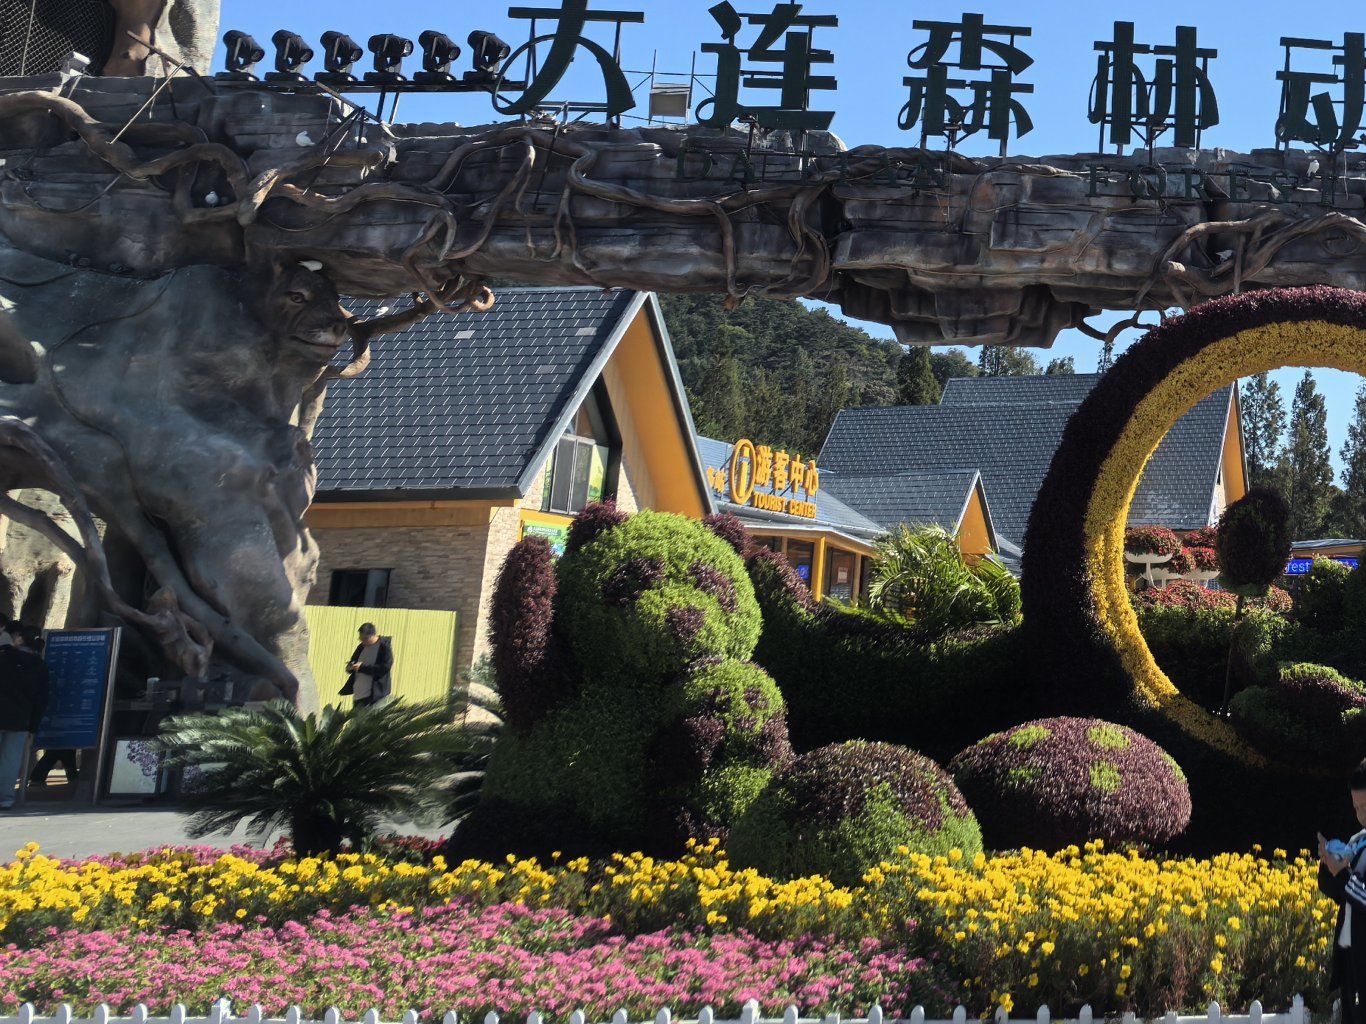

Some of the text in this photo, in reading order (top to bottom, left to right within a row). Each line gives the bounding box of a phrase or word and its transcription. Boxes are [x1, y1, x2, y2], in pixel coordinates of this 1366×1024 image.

[755, 445, 819, 496] 游客中心
[753, 492, 817, 519] TOURIST CENTER
